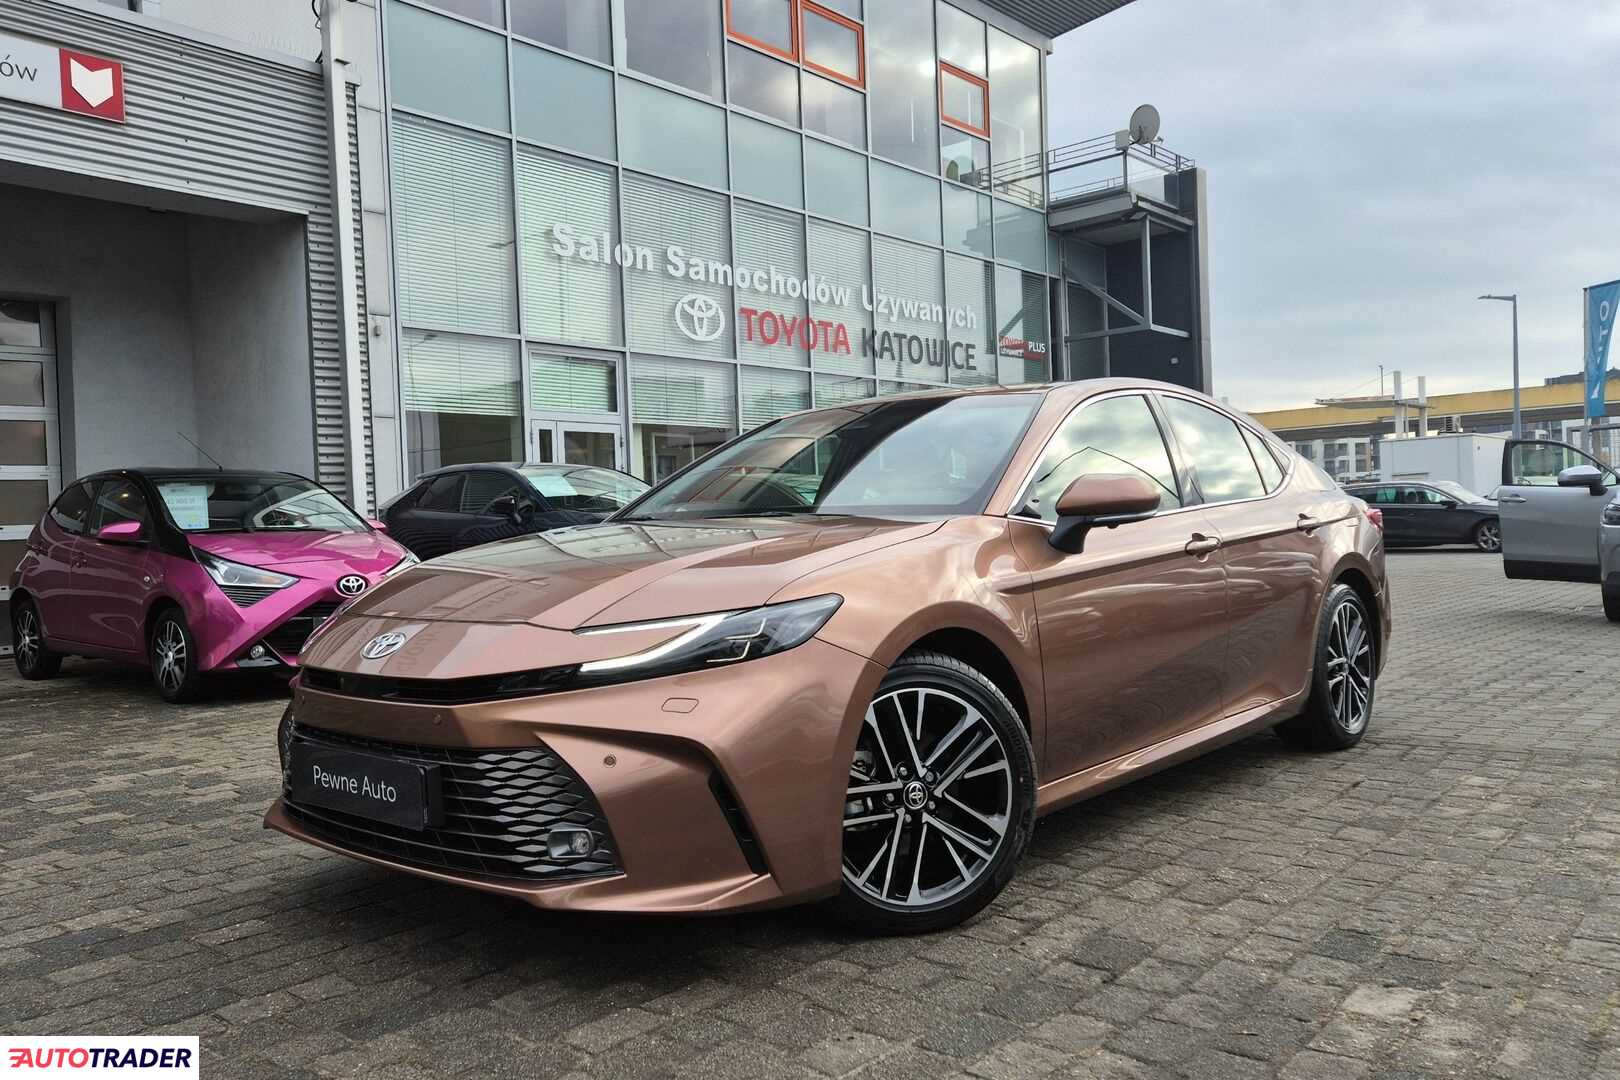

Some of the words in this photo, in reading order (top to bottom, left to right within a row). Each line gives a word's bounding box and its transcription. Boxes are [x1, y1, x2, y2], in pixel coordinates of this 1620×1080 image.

[552, 222, 653, 271] Salon
[666, 245, 849, 306] Samochodów
[862, 284, 977, 329] Używanych
[738, 306, 851, 355] TOYOTA
[861, 327, 977, 371] KATOWICE
[1028, 341, 1046, 353] PLUS
[313, 765, 358, 794] Pewne
[361, 775, 397, 802] Auto
